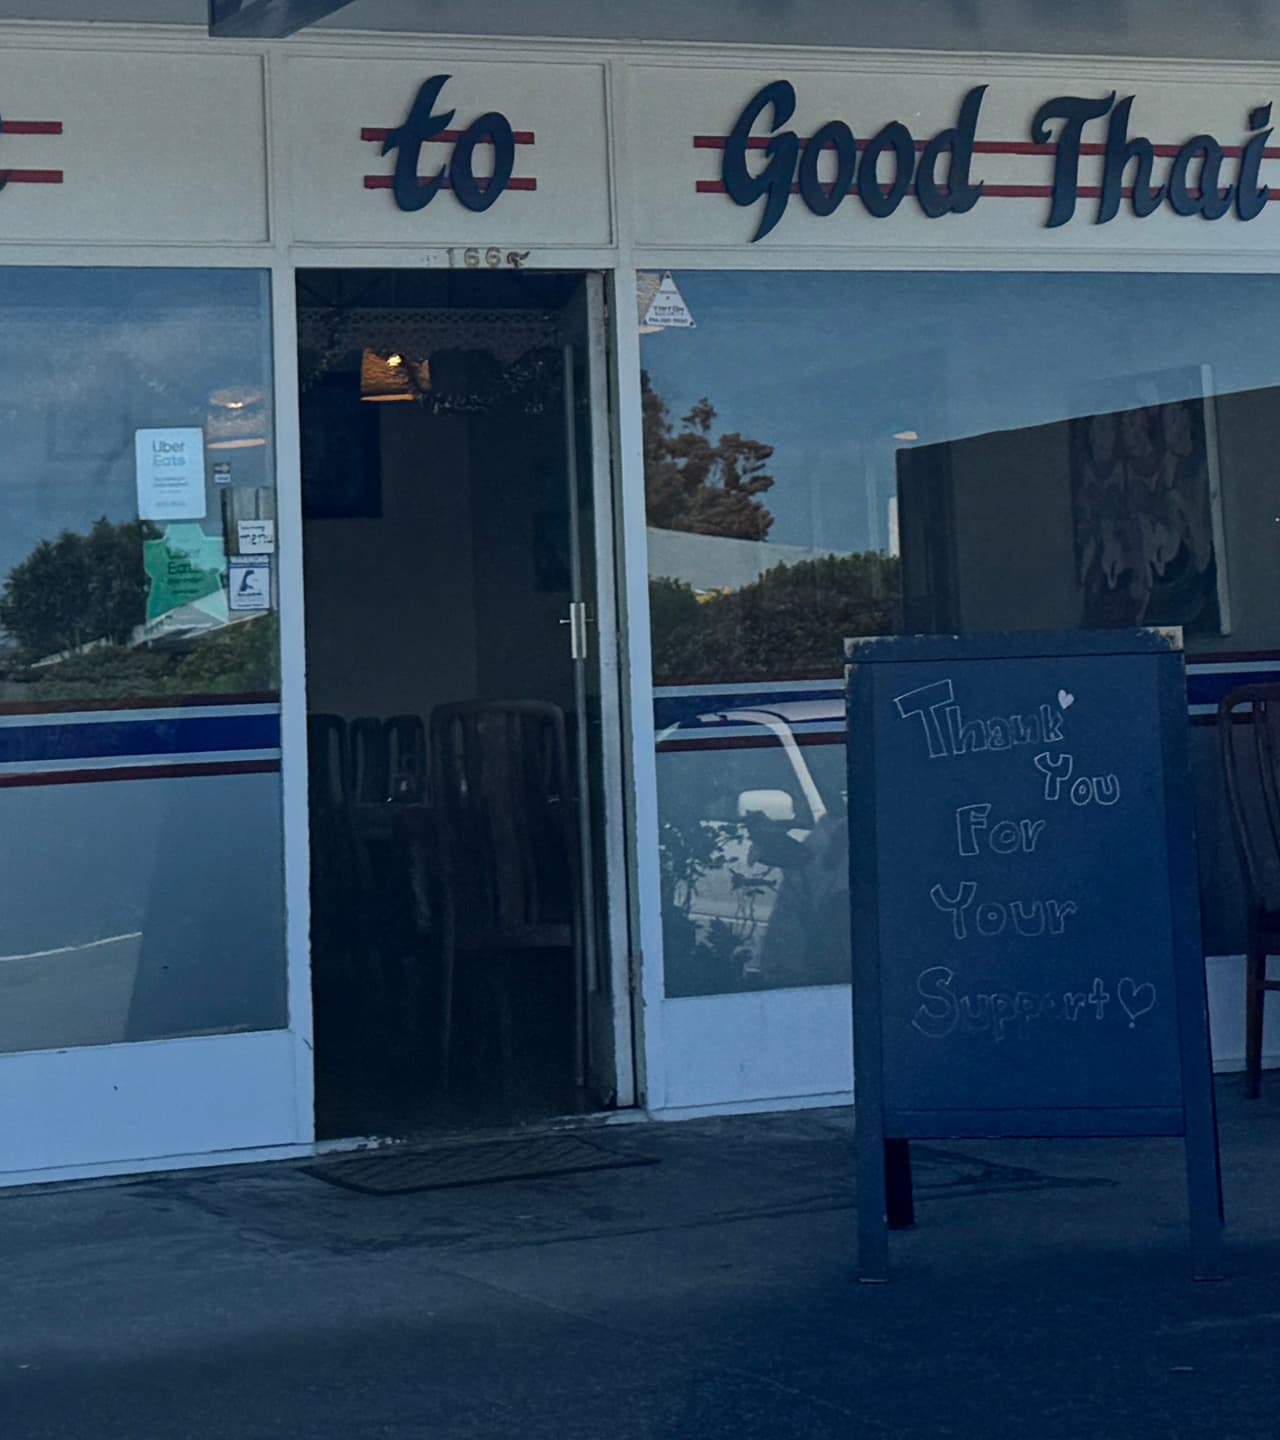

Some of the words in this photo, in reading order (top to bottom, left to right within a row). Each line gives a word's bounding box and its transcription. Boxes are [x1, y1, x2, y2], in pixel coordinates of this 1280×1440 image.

[381, 74, 515, 212] to
[722, 79, 990, 244] Good
[1033, 85, 1274, 229] Thai
[152, 440, 185, 453] Uber
[152, 454, 187, 467] Eats
[893, 679, 1064, 759] Thank
[1033, 751, 1120, 807] You
[956, 803, 1046, 857] For
[929, 881, 1079, 941] Your
[911, 965, 1111, 1041] Supprt
